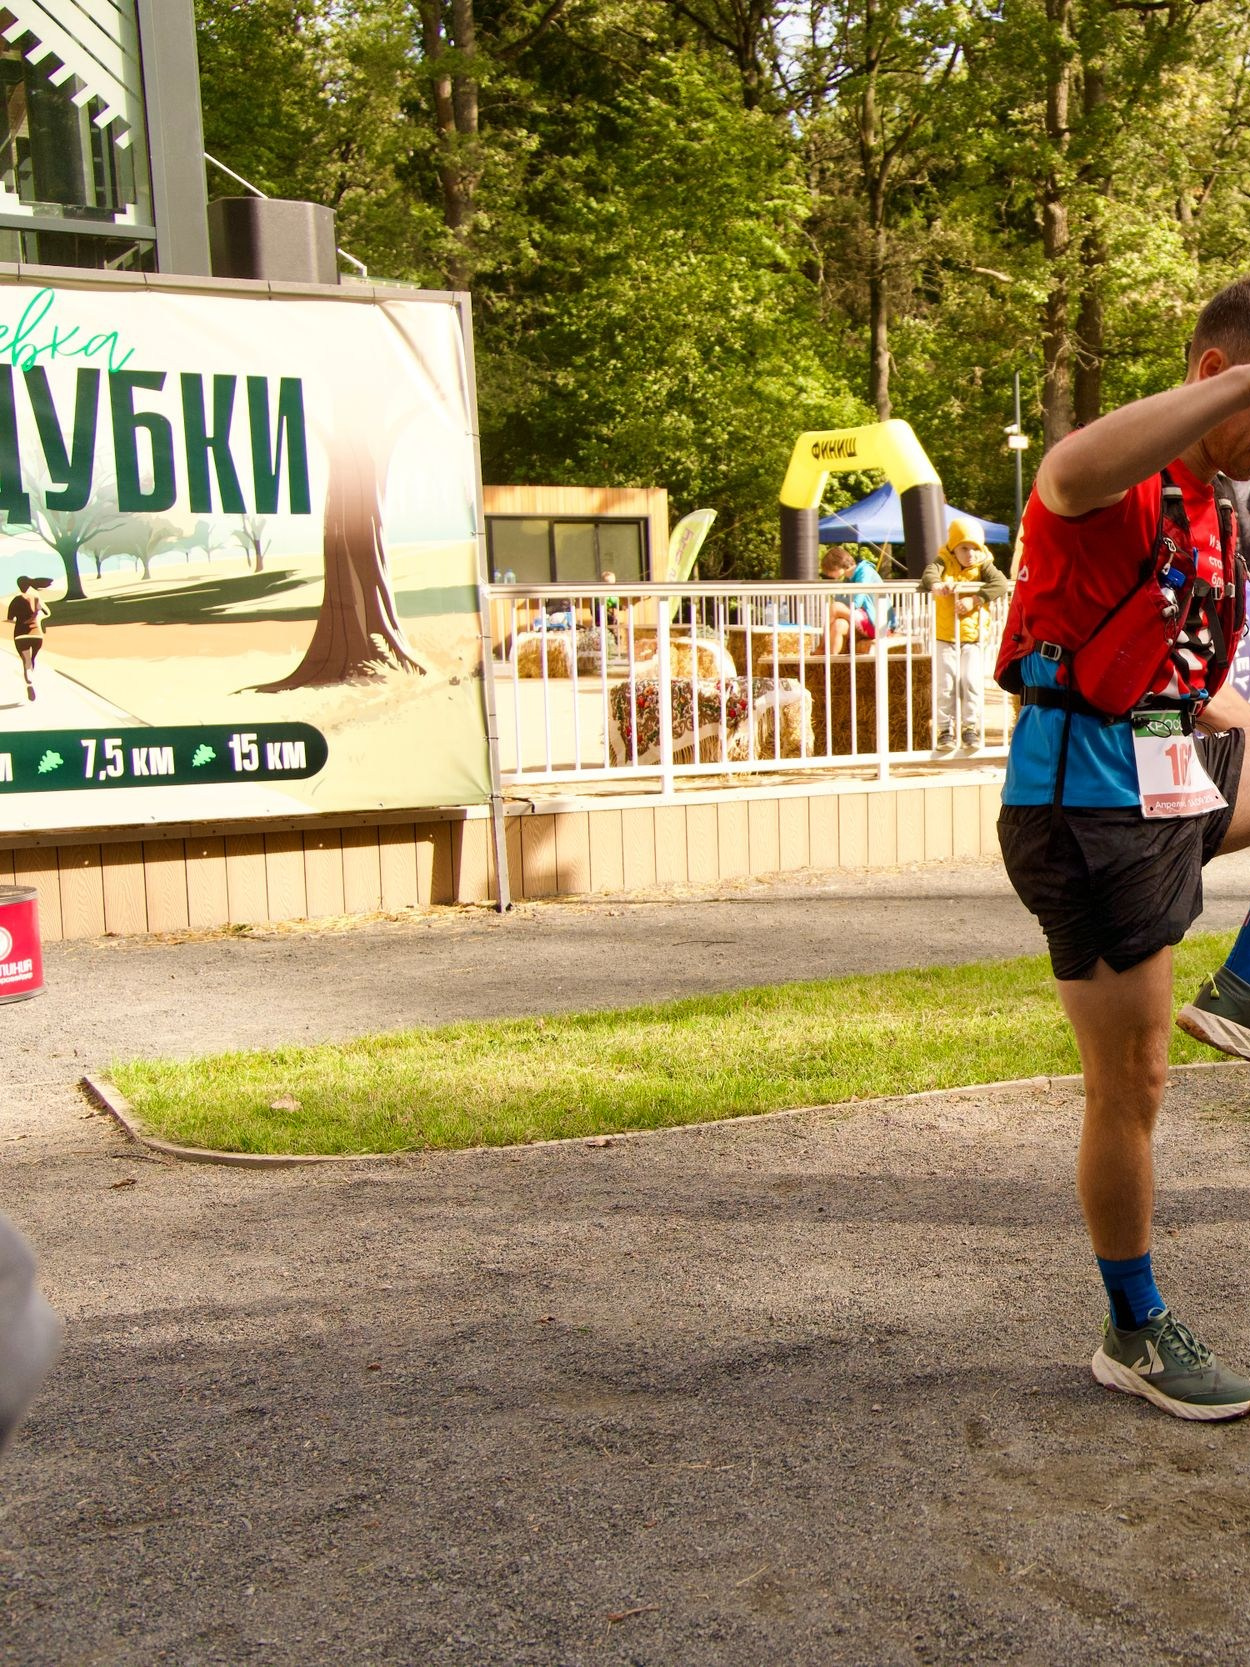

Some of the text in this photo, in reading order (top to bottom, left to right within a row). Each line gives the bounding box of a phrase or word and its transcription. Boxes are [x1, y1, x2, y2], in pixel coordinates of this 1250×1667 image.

[811, 437, 858, 461] ФИНИШ
[80, 737, 125, 781] 7,5
[229, 733, 259, 772] 15
